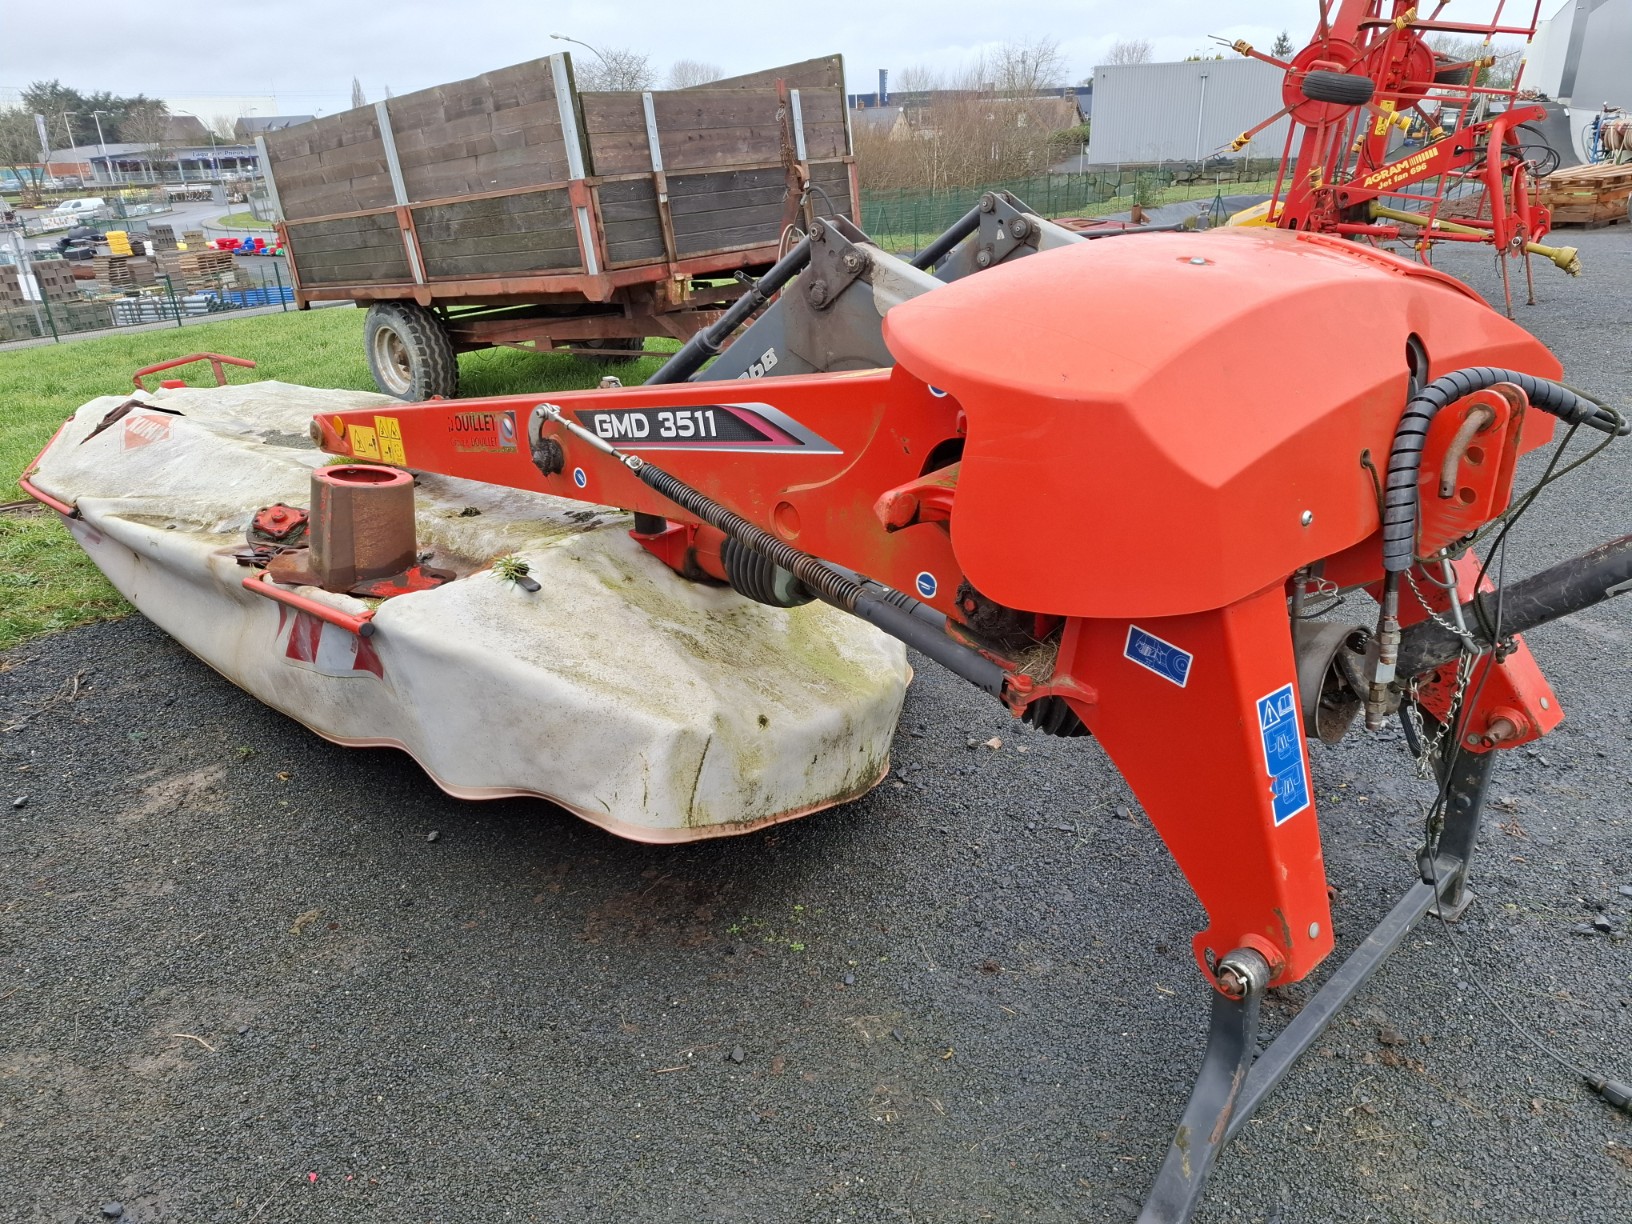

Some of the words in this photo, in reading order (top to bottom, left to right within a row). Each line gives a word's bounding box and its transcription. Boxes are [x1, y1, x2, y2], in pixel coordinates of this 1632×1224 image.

[1363, 160, 1410, 187] AGRAM
[1378, 179, 1392, 190] Jet
[1394, 172, 1409, 183] fan
[1410, 162, 1427, 175] 696
[126, 415, 169, 441] KUHN
[594, 412, 650, 438] GMD
[658, 410, 717, 437] 3511
